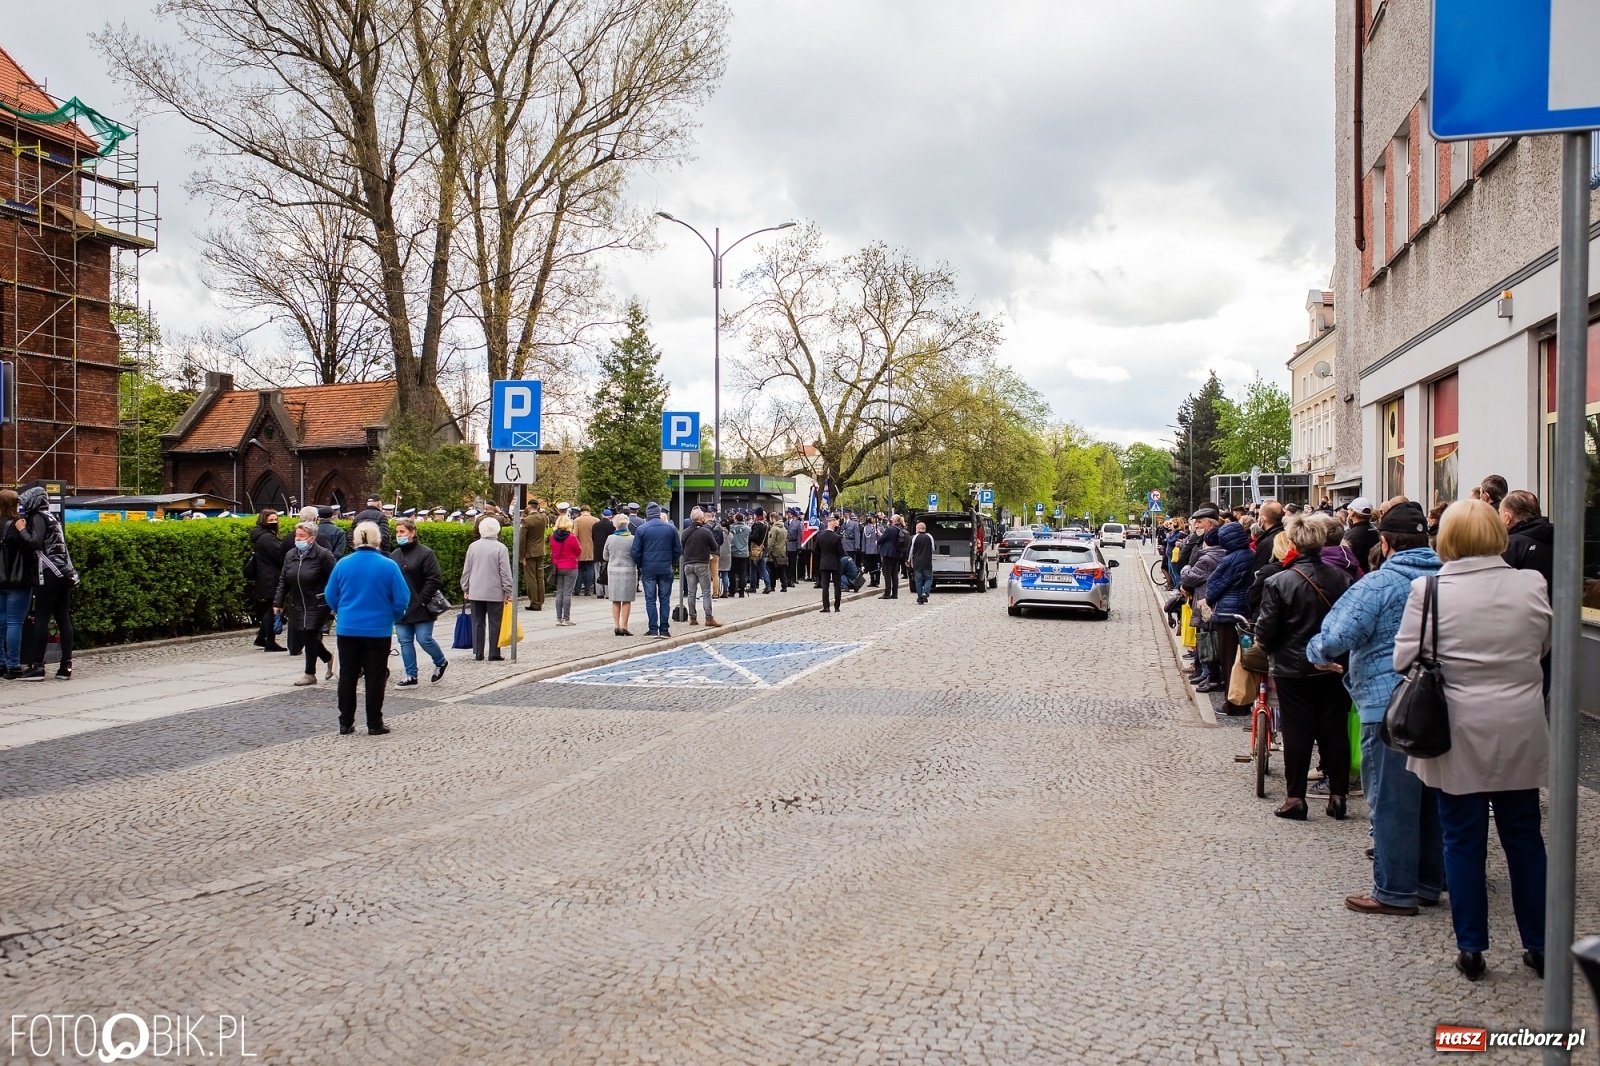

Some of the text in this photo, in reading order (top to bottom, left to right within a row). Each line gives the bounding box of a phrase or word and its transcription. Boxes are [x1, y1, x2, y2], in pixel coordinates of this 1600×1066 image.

[503, 386, 532, 429] P
[670, 415, 692, 446] P
[722, 478, 749, 487] RUCH
[930, 494, 937, 502] P
[983, 491, 991, 502] P
[1037, 503, 1043, 511] P
